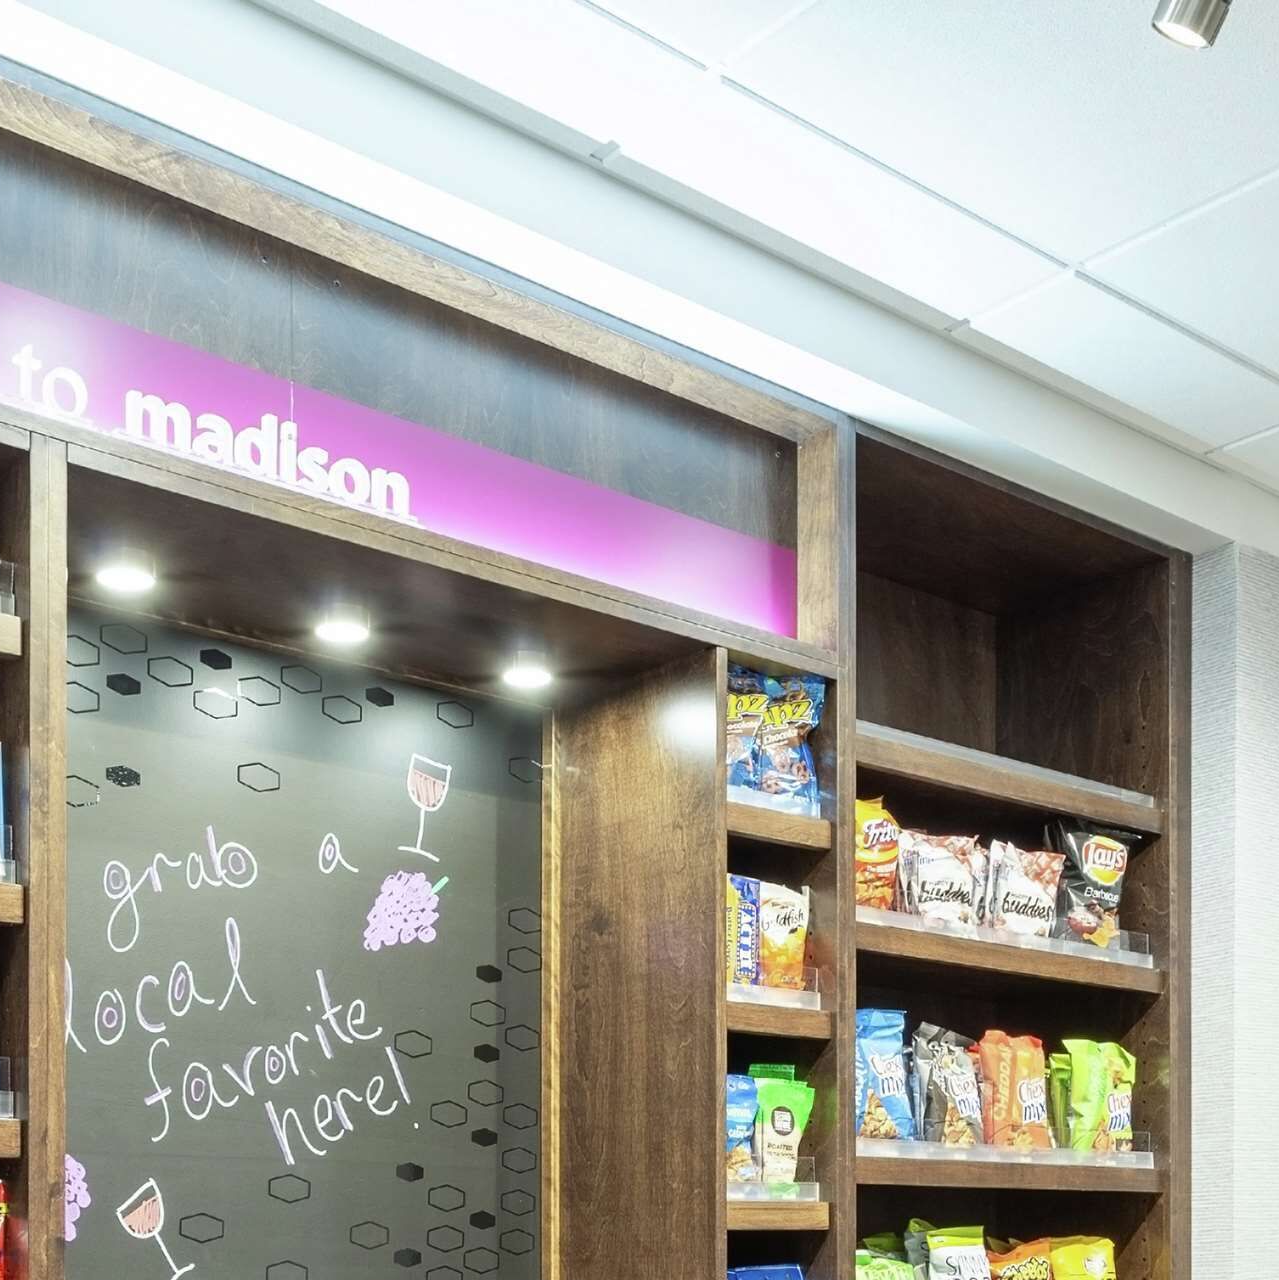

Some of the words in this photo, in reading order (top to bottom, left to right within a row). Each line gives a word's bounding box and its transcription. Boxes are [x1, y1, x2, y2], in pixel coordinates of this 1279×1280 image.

[13, 345, 89, 417] to
[126, 389, 414, 516] madison
[104, 824, 258, 952] grab
[319, 832, 359, 874] a
[143, 968, 383, 1143] favorite
[264, 1045, 421, 1165] here!
